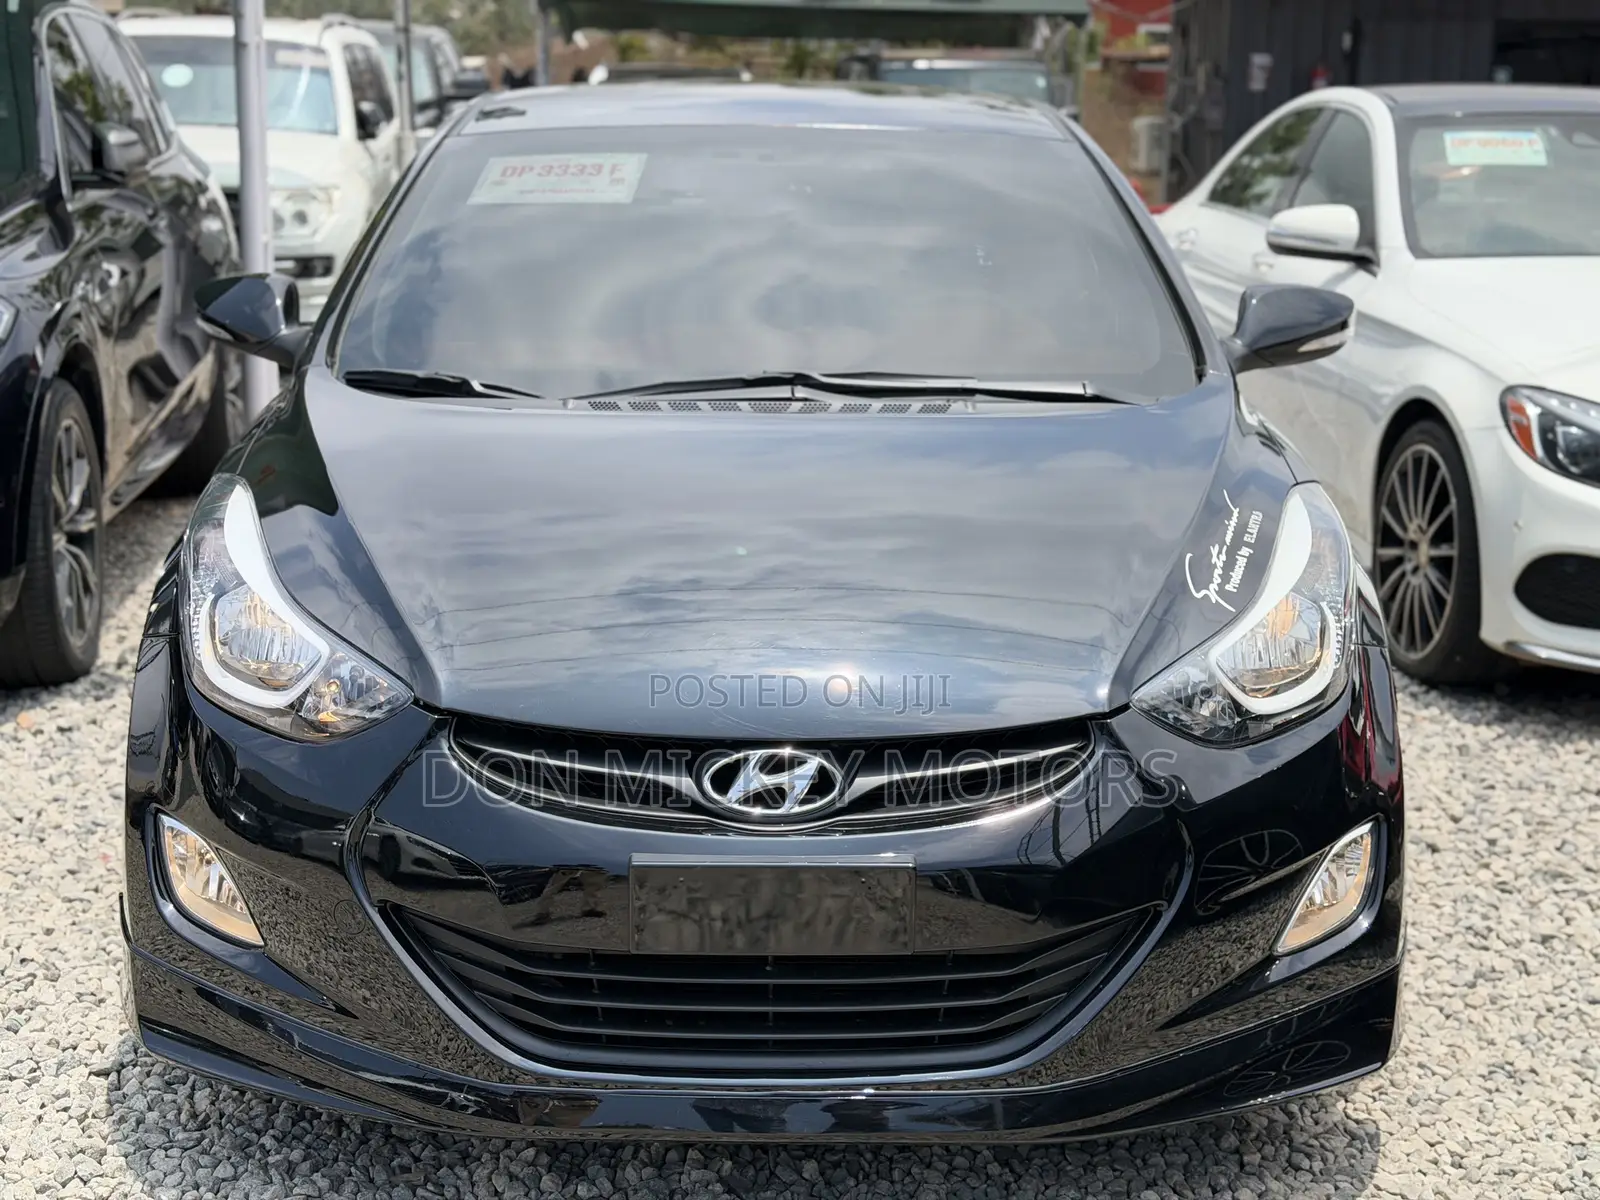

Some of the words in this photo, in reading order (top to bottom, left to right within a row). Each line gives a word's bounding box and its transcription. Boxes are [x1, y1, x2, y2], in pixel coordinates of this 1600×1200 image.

[501, 165, 534, 177] DP
[1243, 510, 1263, 543] ELANTRA
[1236, 546, 1254, 557] by
[1225, 555, 1248, 592] Produced
